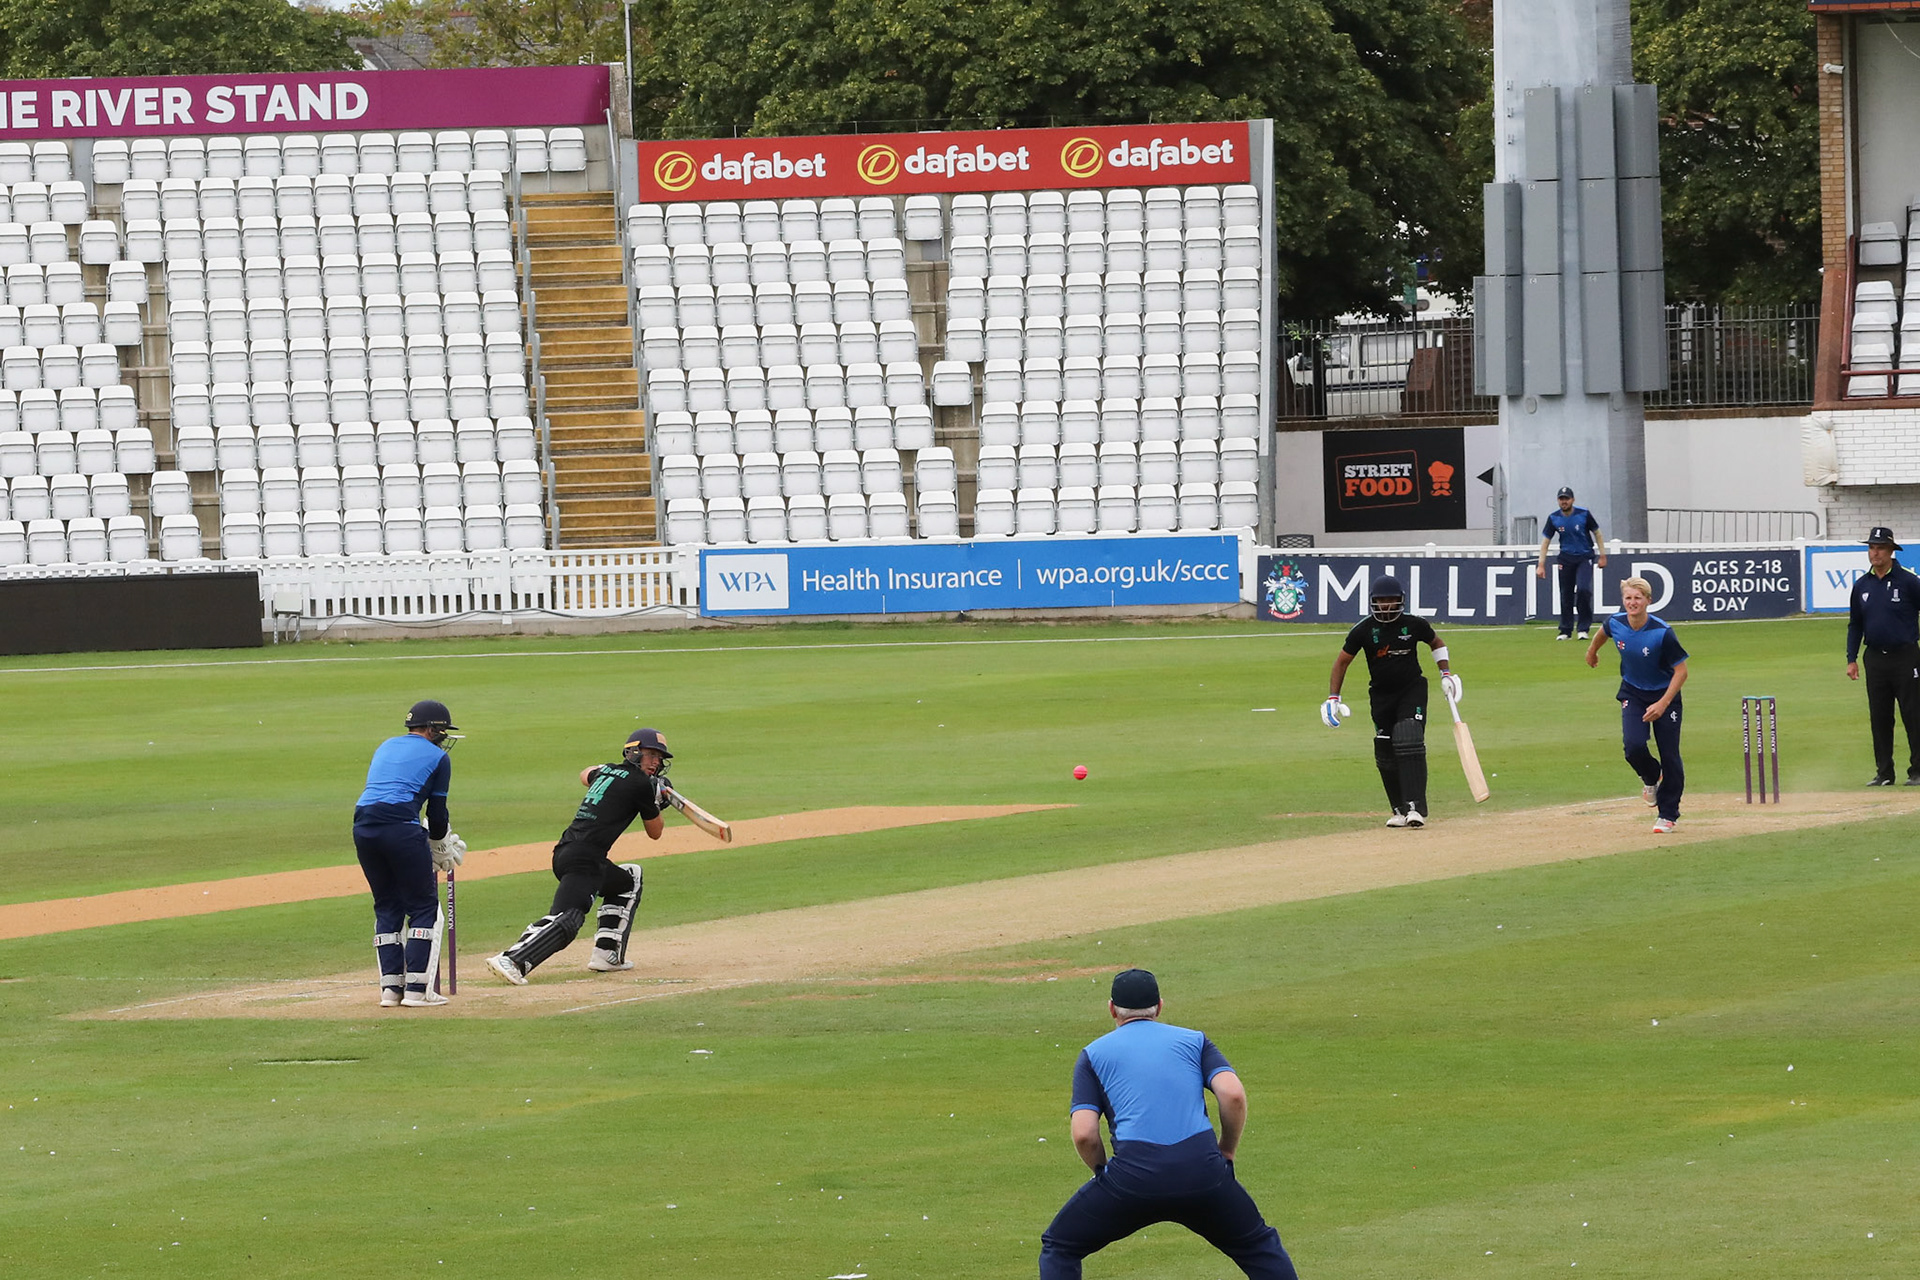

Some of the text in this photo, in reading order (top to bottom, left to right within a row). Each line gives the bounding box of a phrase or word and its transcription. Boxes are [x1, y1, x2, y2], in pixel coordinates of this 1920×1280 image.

[0, 82, 369, 129] E RIVER STAND
[701, 151, 826, 185] dafabet
[904, 144, 1030, 179] dafabet
[1107, 137, 1234, 172] dafabet
[1344, 463, 1413, 478] STREET
[1345, 477, 1413, 497] FOOD
[718, 558, 1230, 592] WPA Health Insurance wpa.org.uk/sccc
[1692, 559, 1782, 576] AGES 2-18
[1825, 569, 1867, 590] WP
[1318, 562, 1674, 617] MLLFILD
[1691, 577, 1790, 594] BOARDING
[1692, 596, 1749, 613] & DAY
